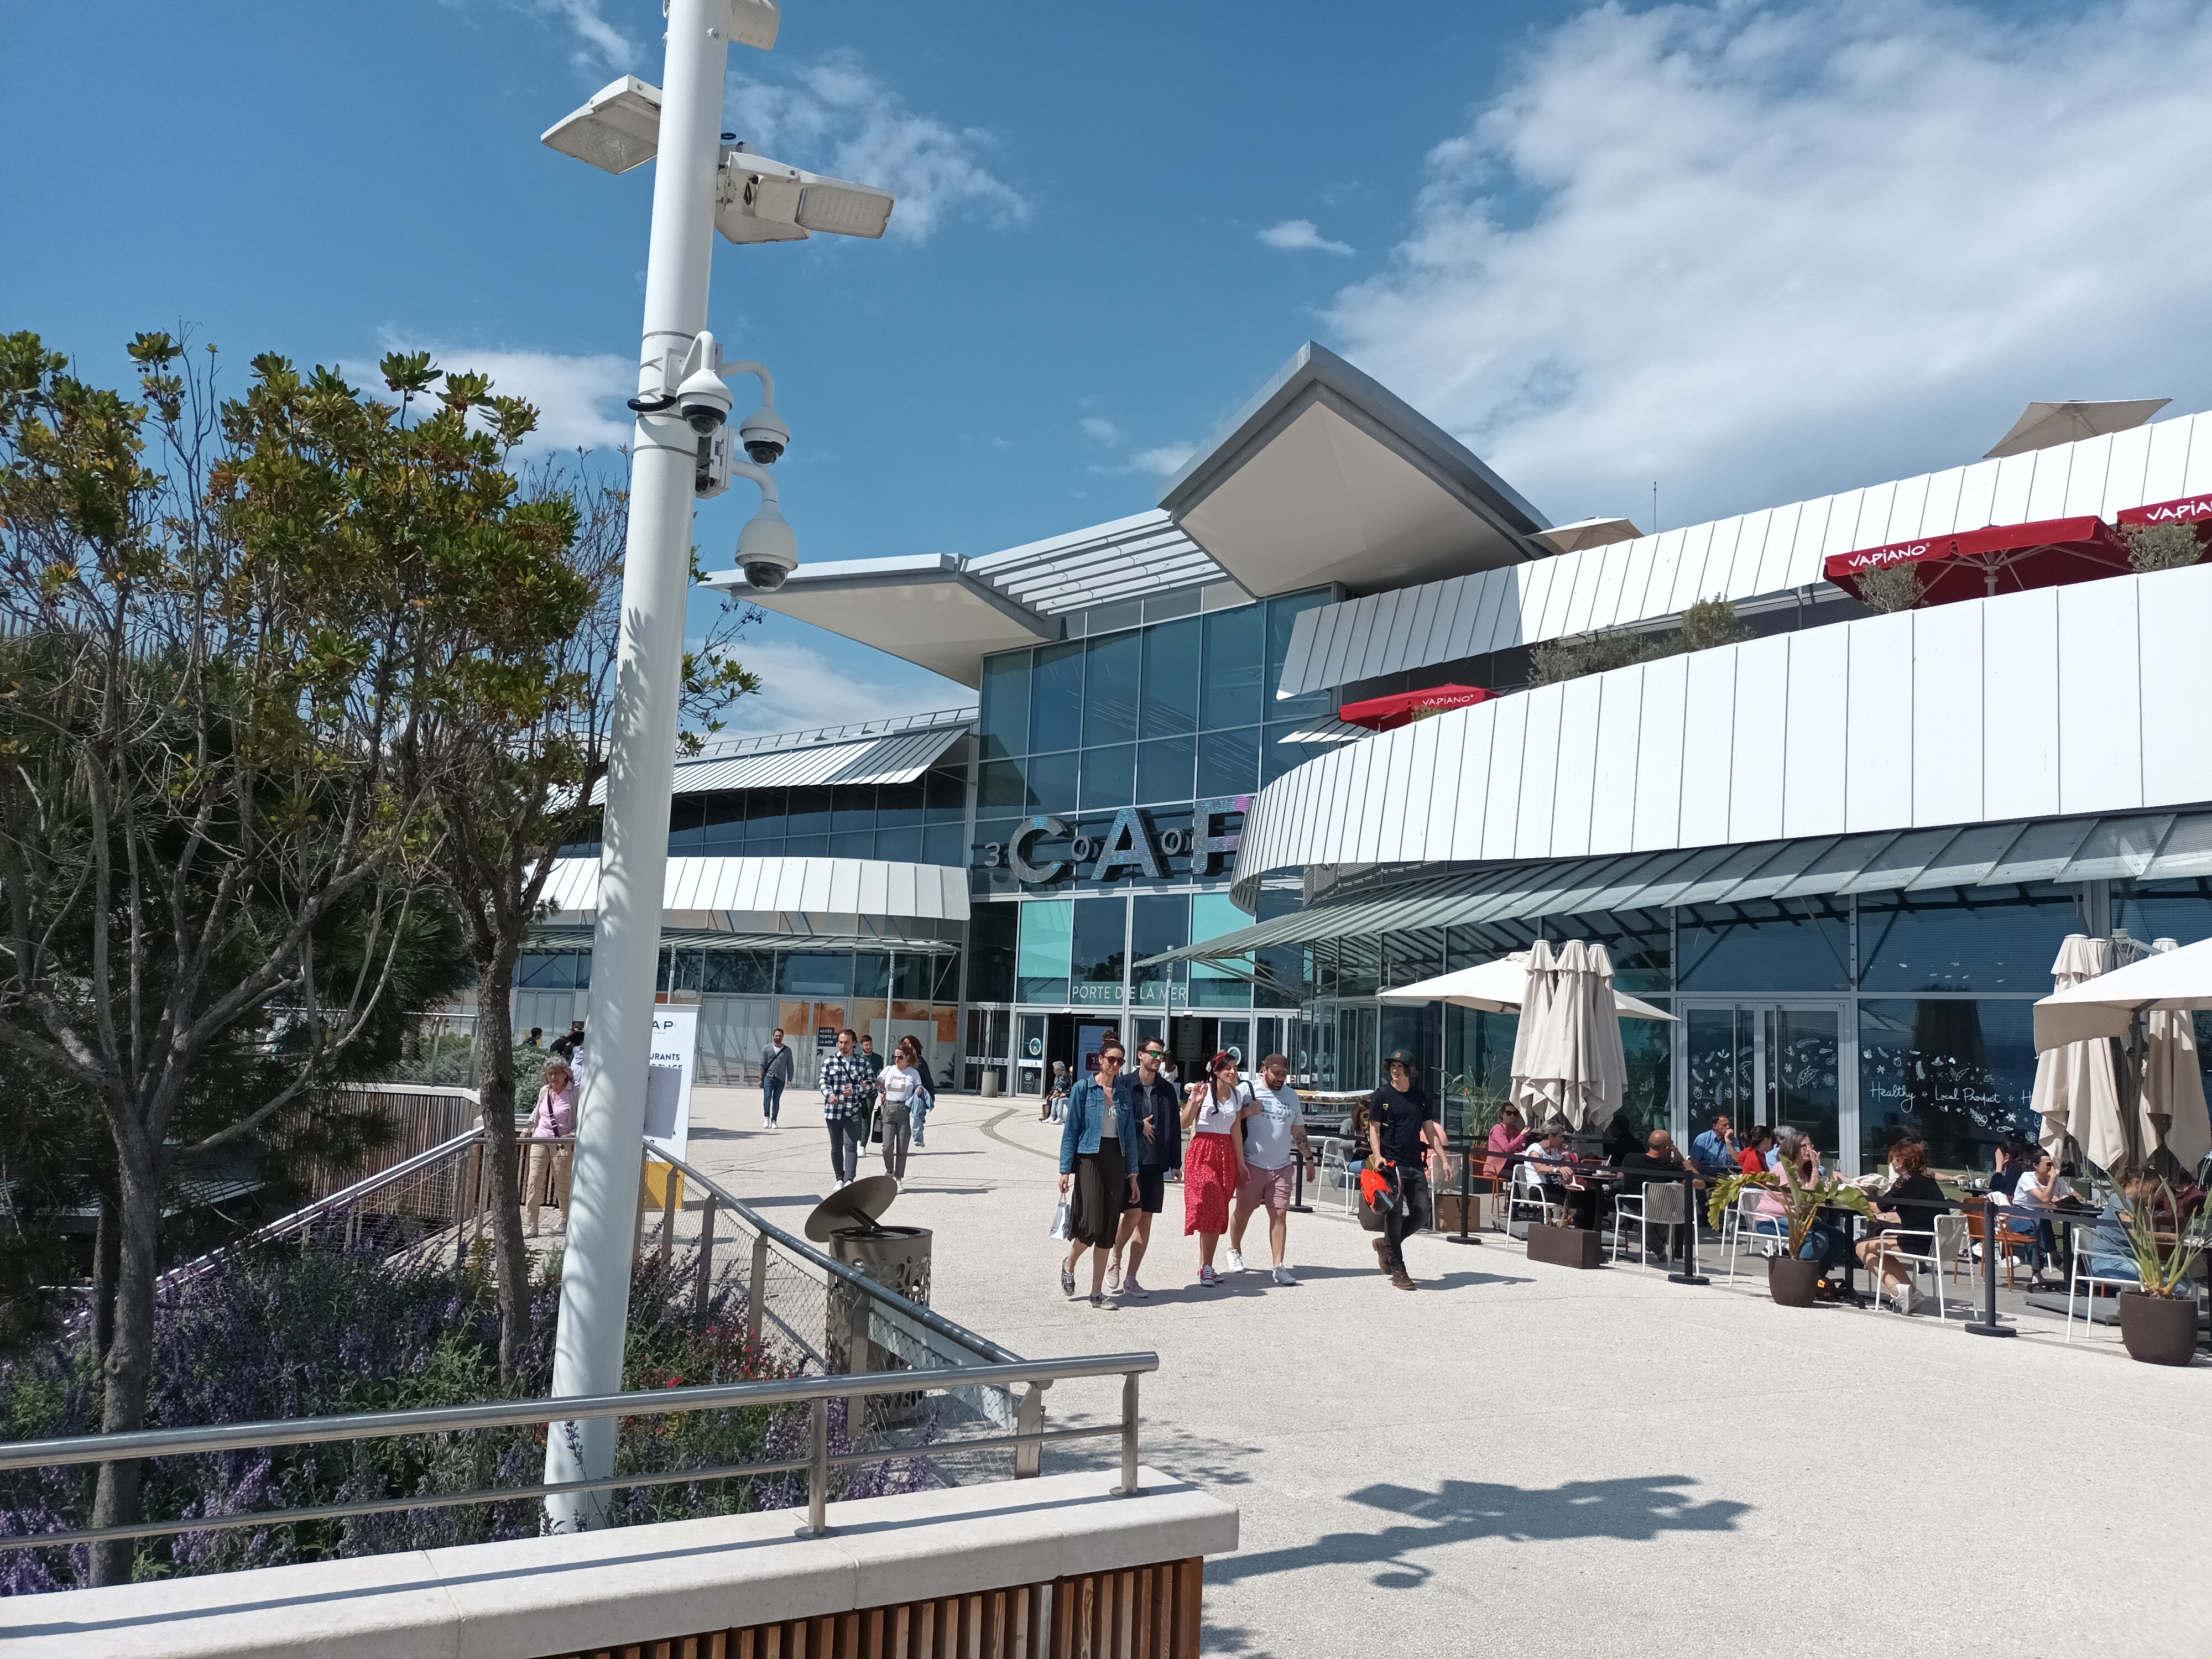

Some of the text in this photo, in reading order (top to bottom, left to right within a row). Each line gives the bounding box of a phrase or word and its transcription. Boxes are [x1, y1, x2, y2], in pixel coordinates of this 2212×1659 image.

[2147, 500, 2212, 520] VAPIA
[1072, 986, 1111, 999] PORTE
[1115, 987, 1136, 999] DE
[1140, 987, 1155, 1000] LA
[1870, 1081, 1916, 1113] Healthy
[1935, 1085, 1960, 1101] Local
[1963, 1087, 2001, 1107] Product
